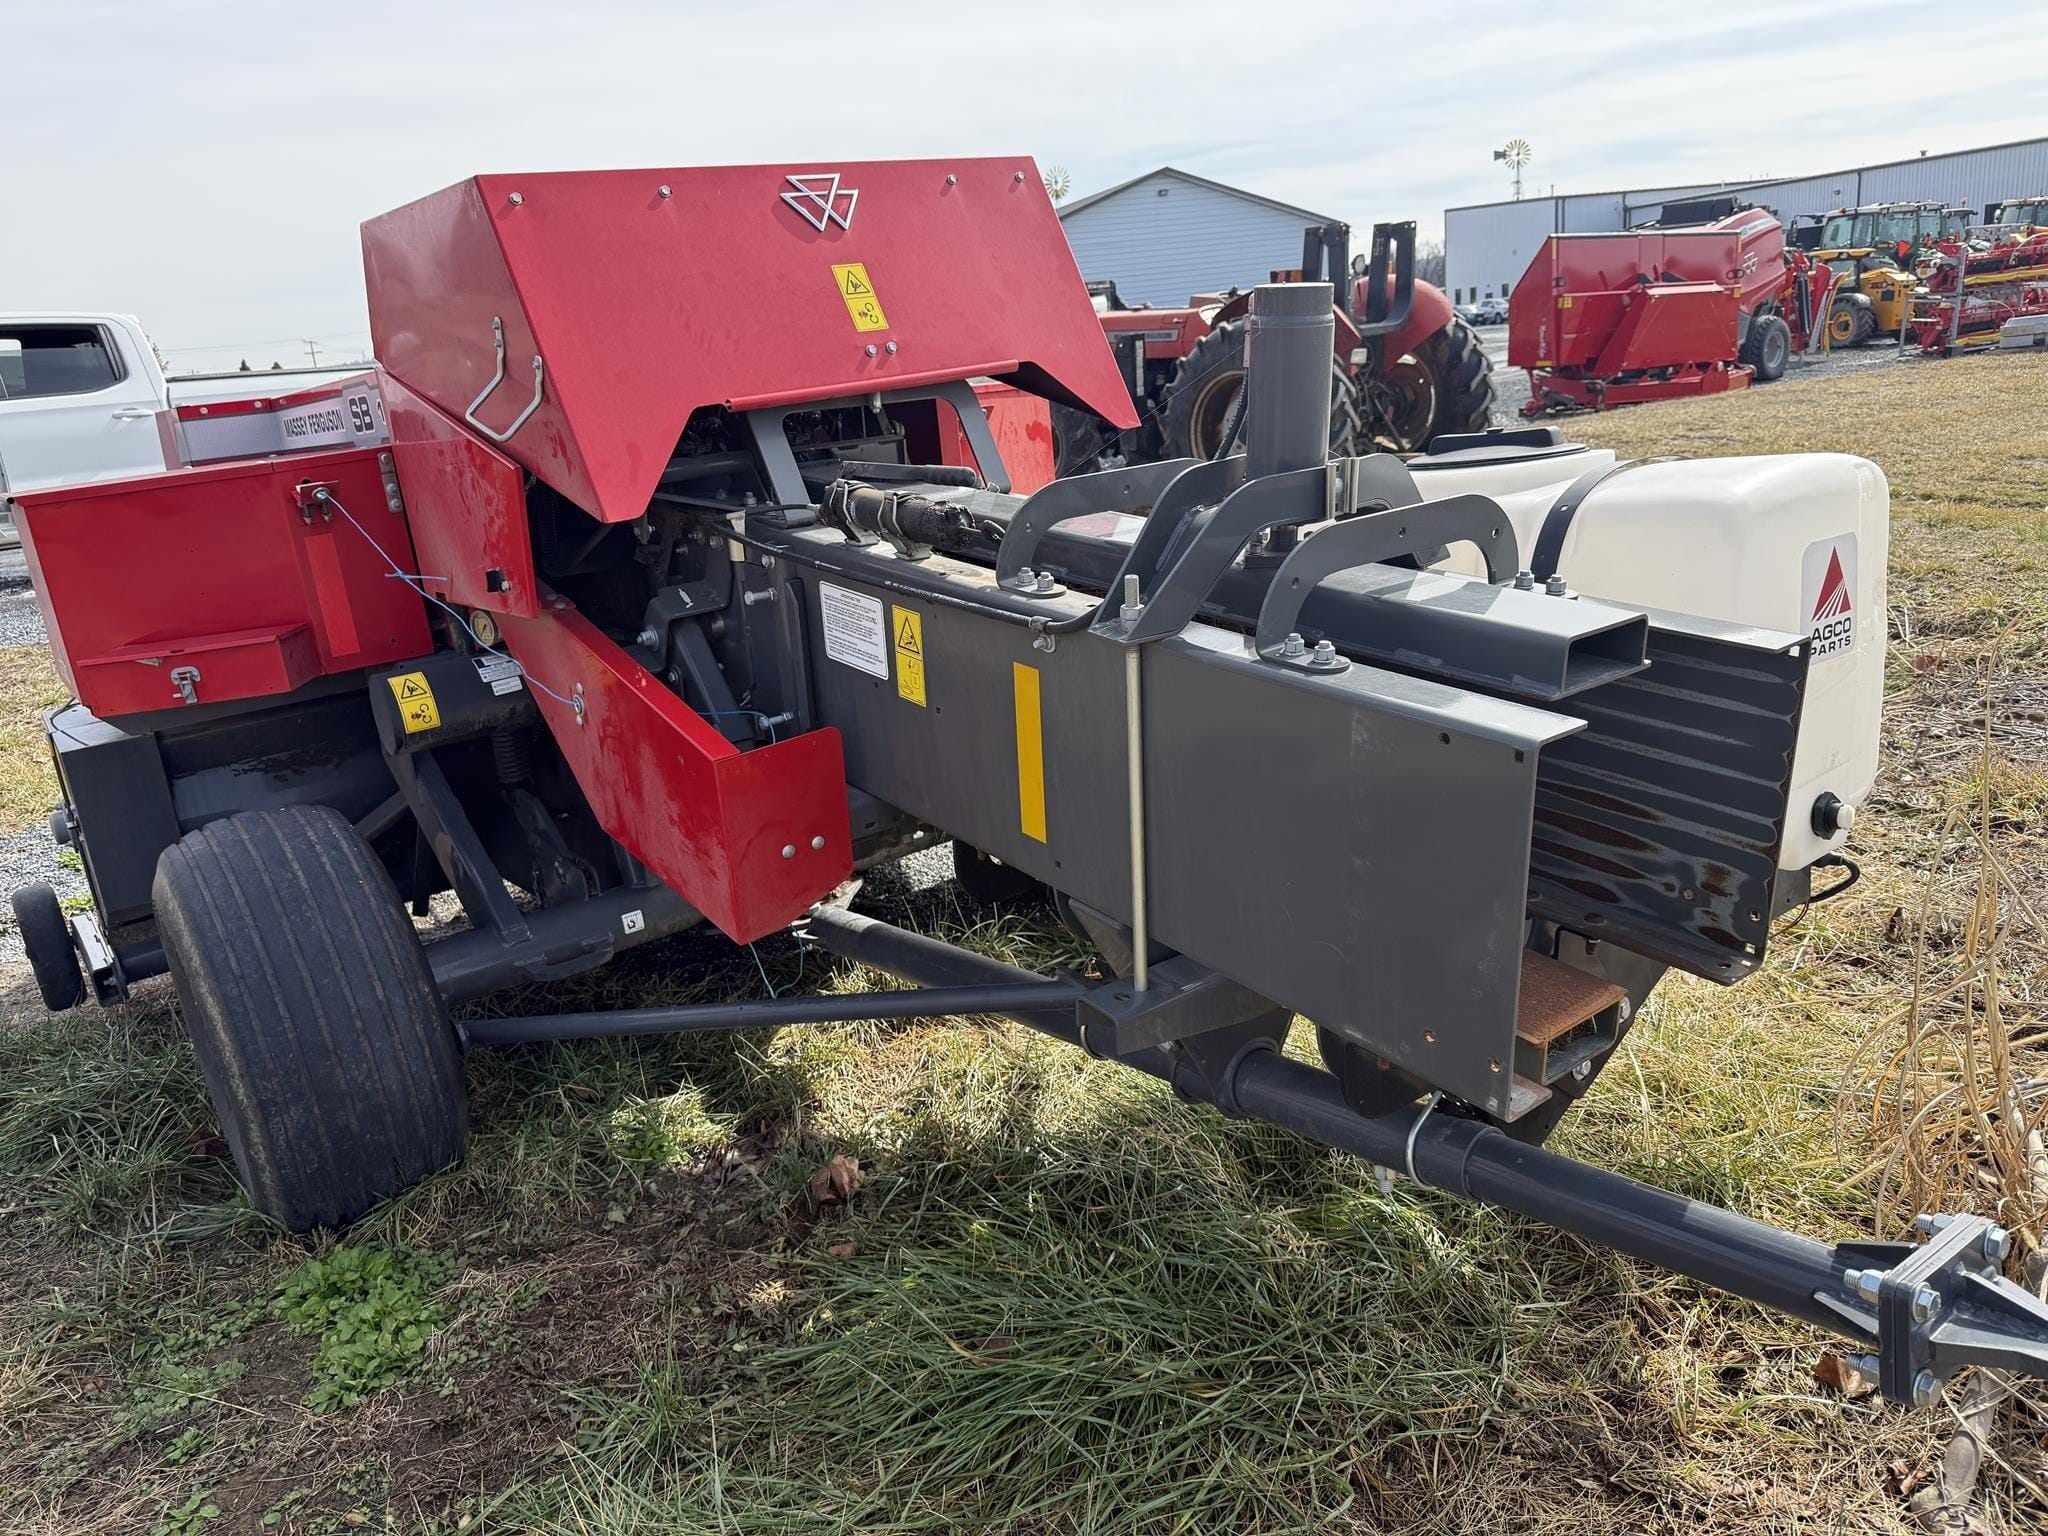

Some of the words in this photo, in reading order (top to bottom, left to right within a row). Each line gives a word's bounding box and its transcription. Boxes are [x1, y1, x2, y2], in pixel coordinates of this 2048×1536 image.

[283, 416, 309, 438] MASSEY
[307, 409, 345, 435] FERGUSON
[349, 395, 374, 433] SB
[1811, 617, 1852, 642] AGCO
